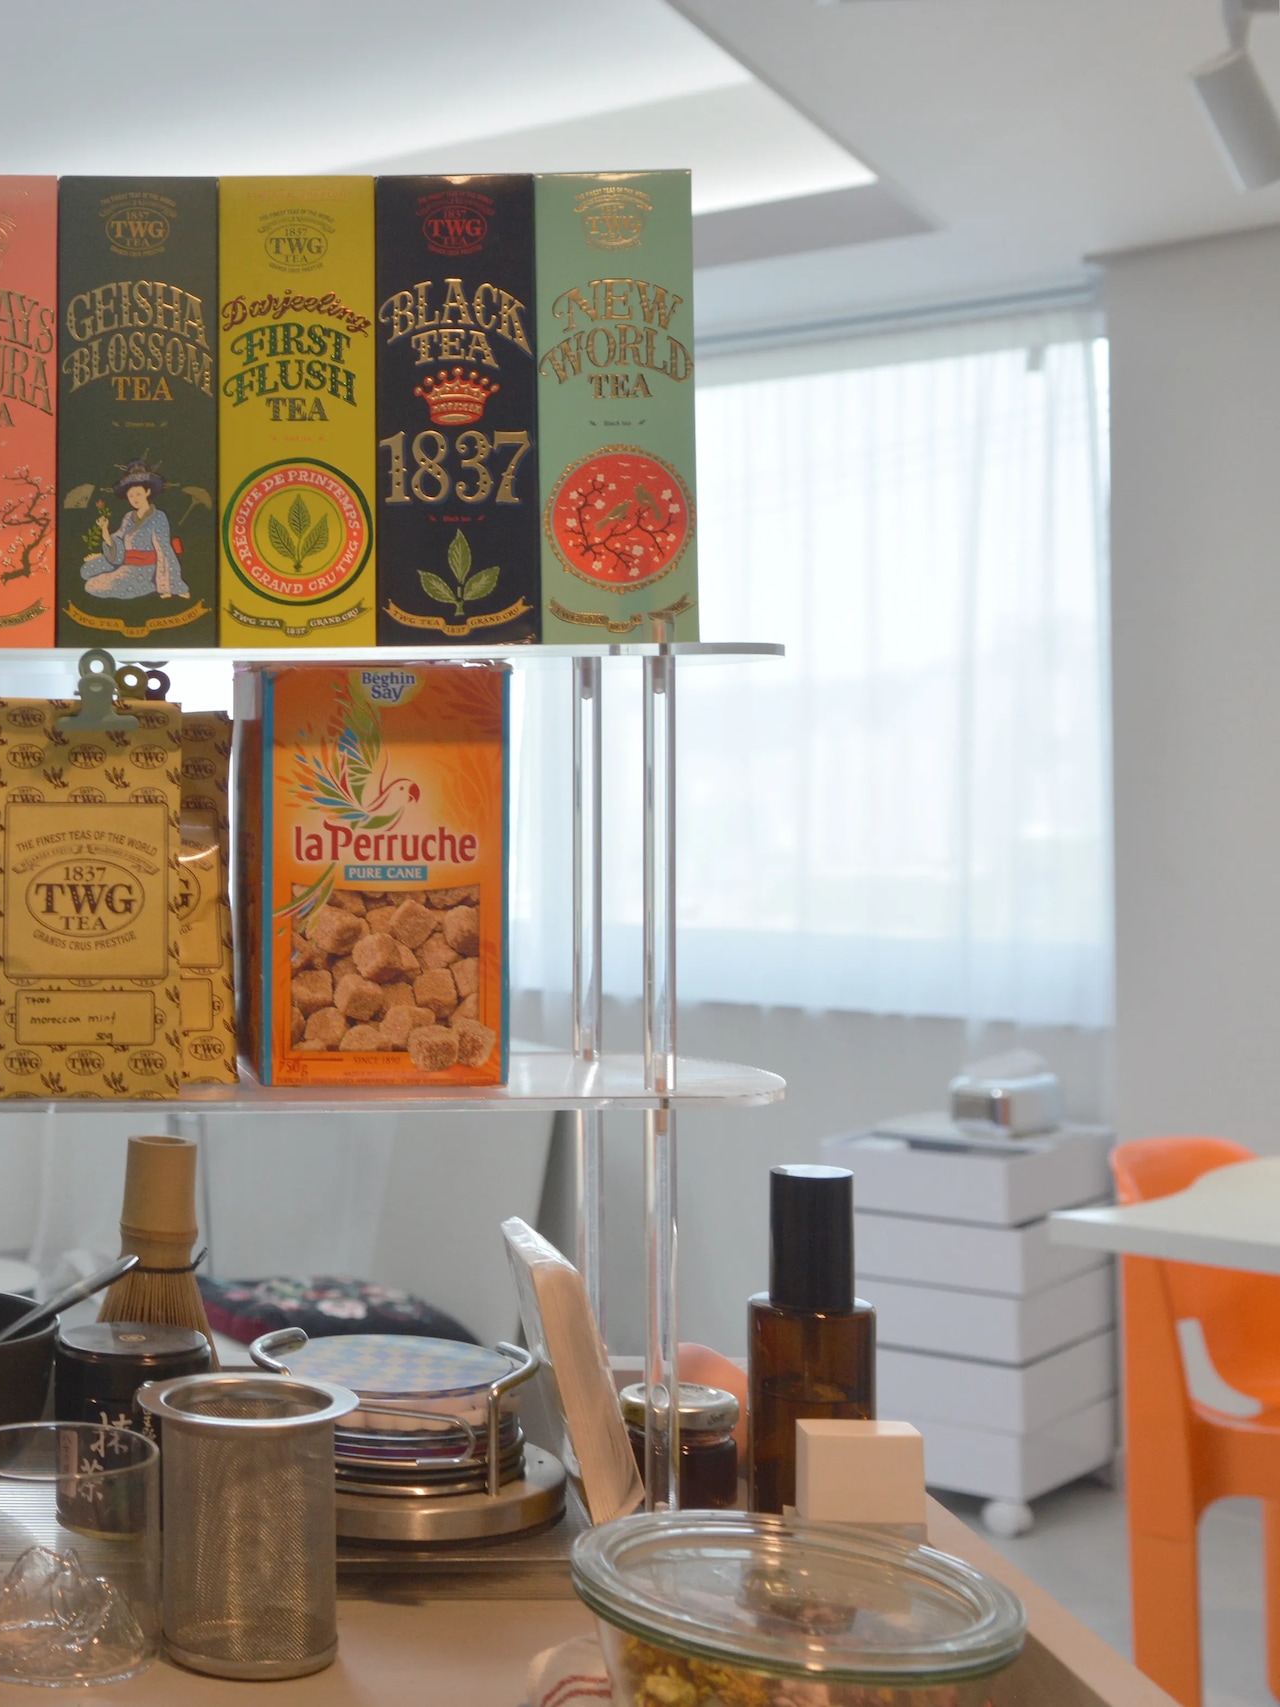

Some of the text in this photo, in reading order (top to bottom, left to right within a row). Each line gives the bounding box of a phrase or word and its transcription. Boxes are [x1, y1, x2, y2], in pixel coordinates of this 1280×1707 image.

[126, 211, 150, 220] 1837
[444, 210, 466, 218] 1837
[111, 220, 166, 238] TWG
[284, 228, 308, 236] 1837
[428, 219, 482, 237] TWG
[586, 216, 641, 234] TWG
[125, 238, 150, 246] TEA
[269, 237, 324, 254] TWG
[444, 236, 468, 245] TEA
[284, 254, 308, 263] TEA
[221, 289, 372, 338] Darjeeling
[552, 277, 684, 333] NEW
[66, 279, 211, 350] GEISHA
[378, 277, 533, 356] BLACK
[230, 322, 351, 367] FIRST
[411, 328, 500, 370] TEA
[538, 323, 695, 385] WORLD
[62, 330, 214, 398] BLOSSOM
[111, 376, 174, 401] TEA
[222, 359, 358, 408] FLUSH
[587, 373, 652, 399] TEA
[265, 397, 329, 422] TEA
[379, 430, 531, 504] 1837
[234, 470, 361, 561] RÉCOLTE DE PRINTEMPS
[251, 539, 360, 595] GRAND CRU TWG
[148, 618, 180, 628] GRAND
[232, 610, 281, 628] TWG TEA
[310, 608, 360, 627] GRAND CRU
[392, 610, 416, 624] TWG
[470, 607, 520, 626] GRAND CRU
[361, 671, 416, 688] Béghin
[371, 685, 404, 702] Say
[8, 714, 44, 723] TWG
[10, 752, 166, 762] TWG TWG TWG
[184, 764, 214, 774] TWG
[16, 840, 34, 852] THE
[36, 832, 66, 847] FINEST
[68, 830, 92, 840] TEAS
[94, 830, 105, 840] OF
[108, 832, 126, 844] THE
[127, 838, 158, 856] WORLD
[63, 866, 106, 882] 1837
[348, 868, 422, 878] PURE CANE
[34, 883, 138, 914] TWG
[59, 916, 108, 931] TEA
[33, 929, 137, 951] GRANDS CRUS PRESTIGE
[192, 1044, 222, 1054] TWG
[6, 1057, 165, 1070] TWG TWG TWG
[278, 1060, 308, 1077] 750g
